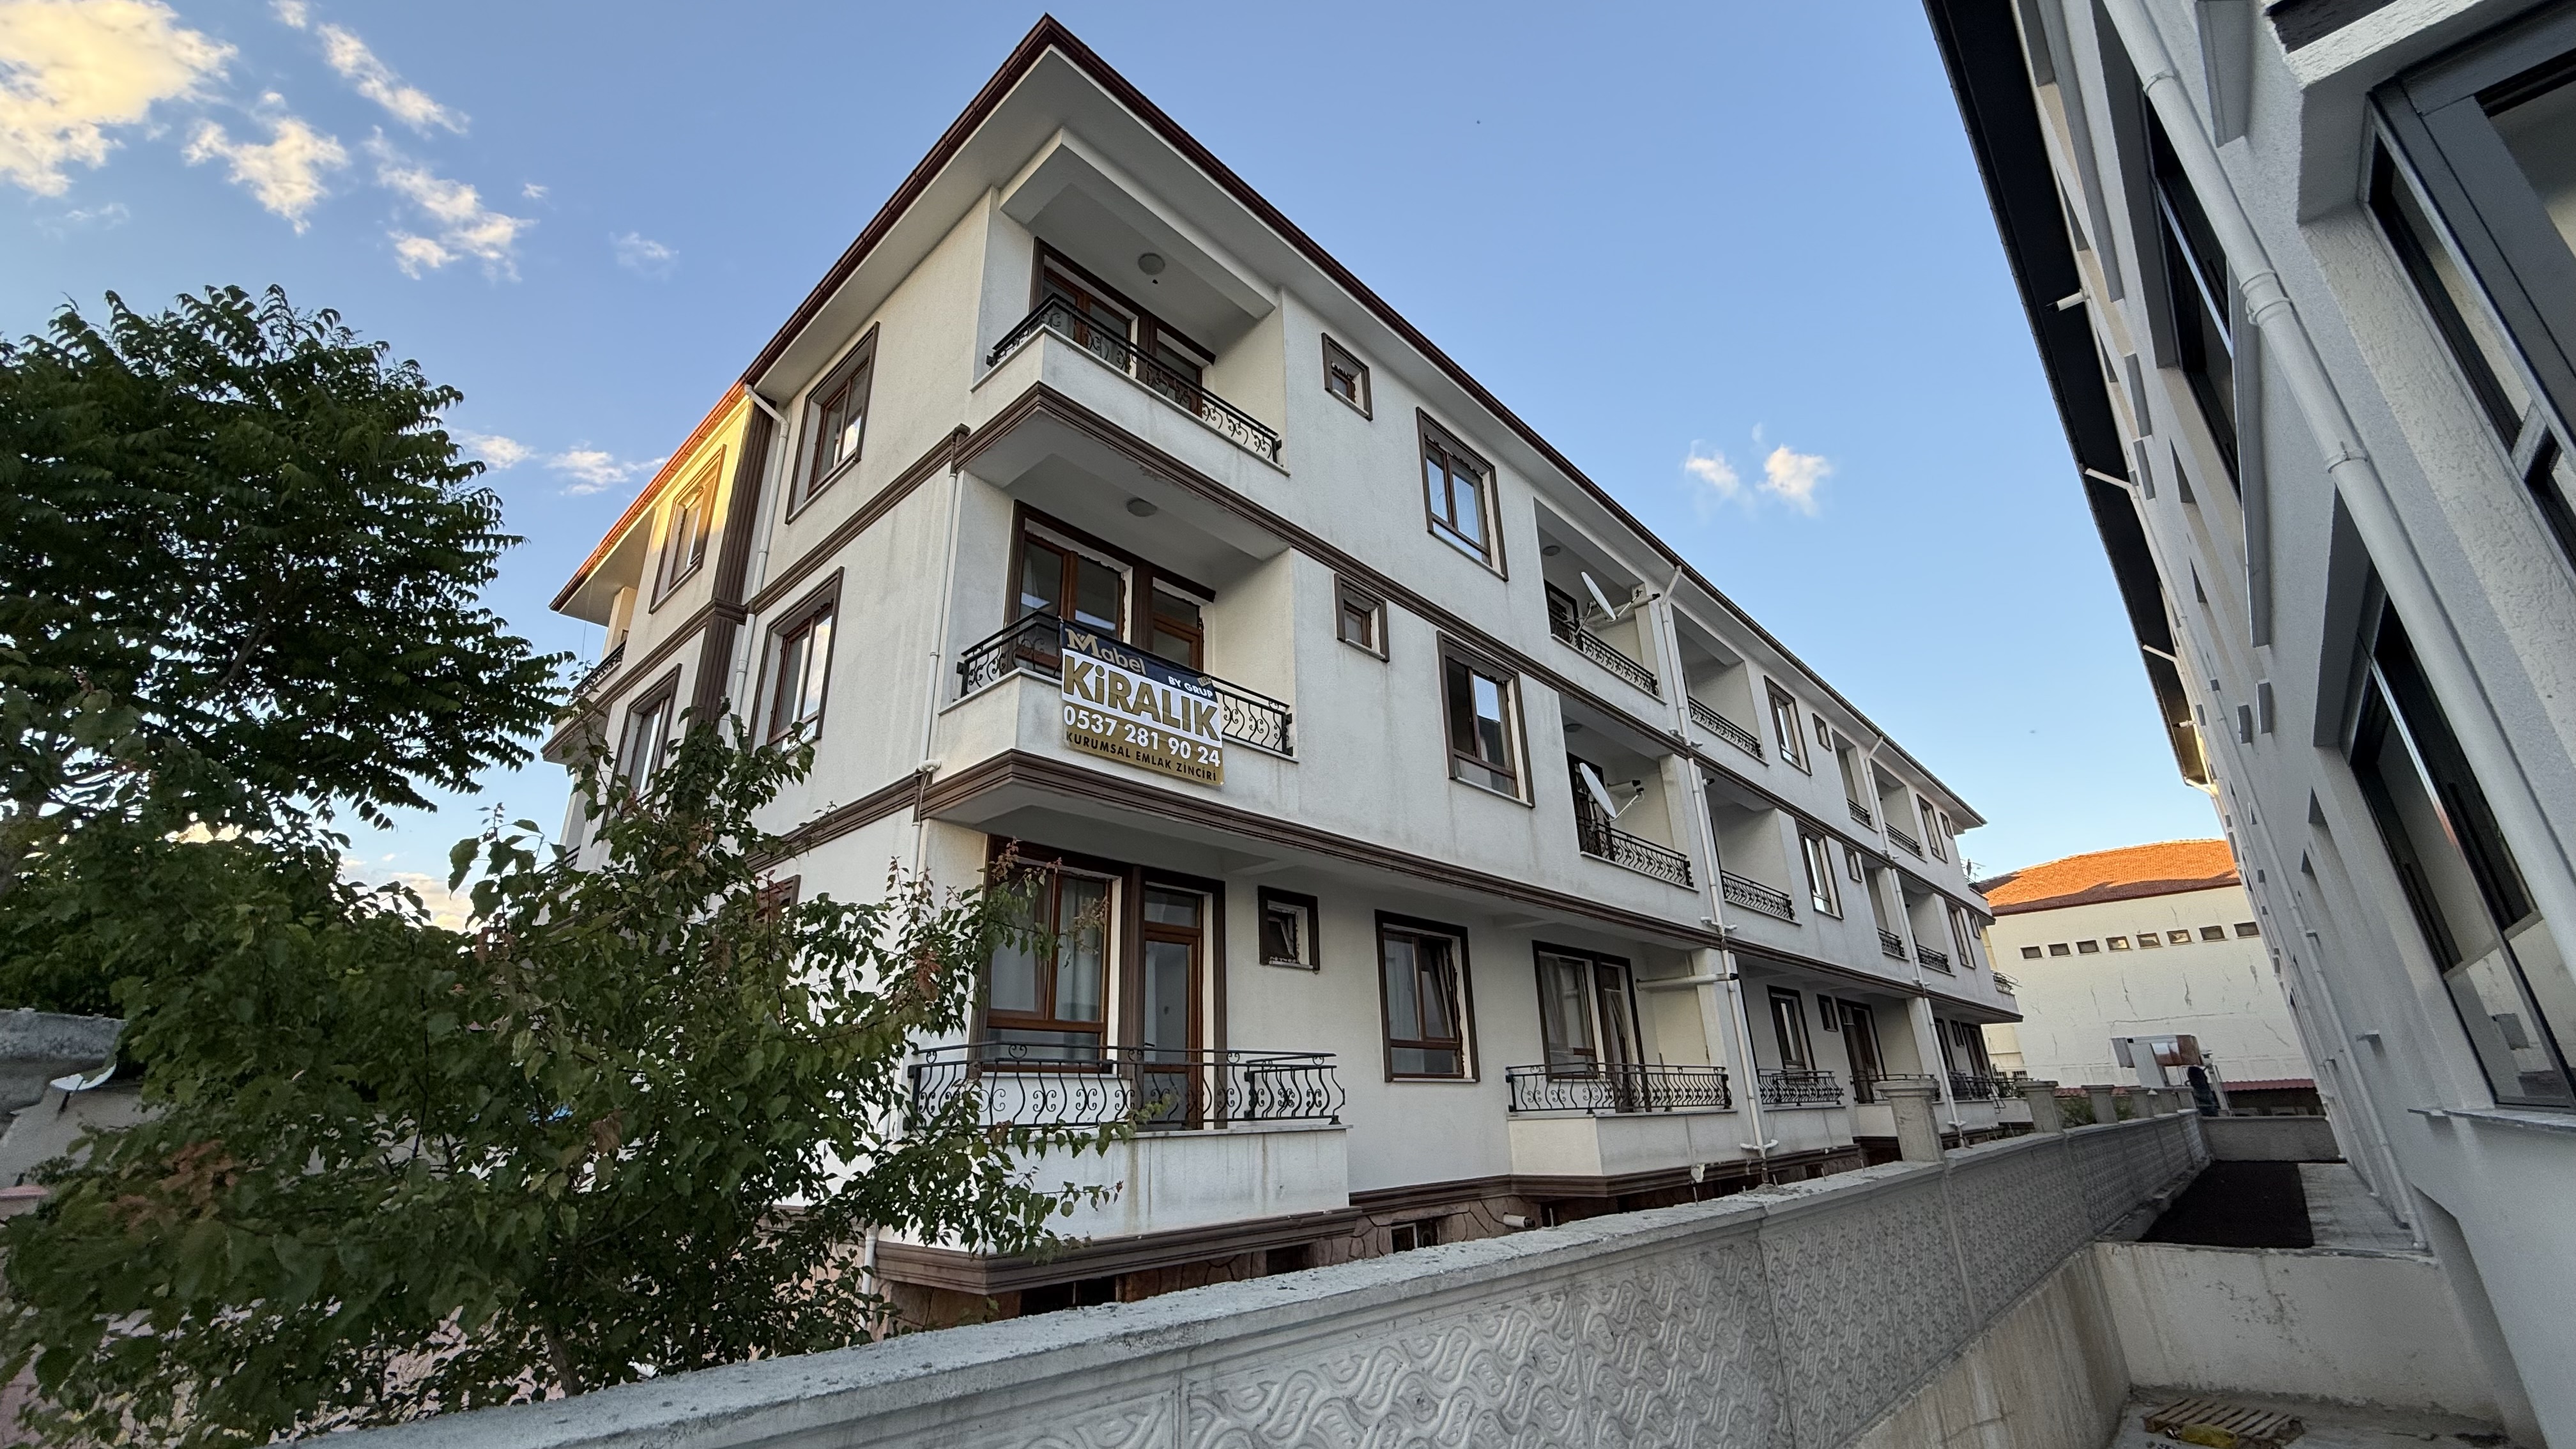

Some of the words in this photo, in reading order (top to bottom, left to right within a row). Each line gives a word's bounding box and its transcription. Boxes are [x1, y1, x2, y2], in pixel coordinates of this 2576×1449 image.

[1065, 628, 1147, 675] Mabel
[1168, 675, 1181, 688] BY
[1184, 682, 1213, 698] GRUP
[1064, 705, 1118, 737] 0537
[1124, 723, 1158, 750] 281
[1168, 737, 1192, 759] 90
[1197, 746, 1221, 767] 24
[1066, 731, 1131, 758] KURUMSAL
[1136, 751, 1172, 770] EMLAK
[1176, 761, 1216, 781] ZİNCİRİ
